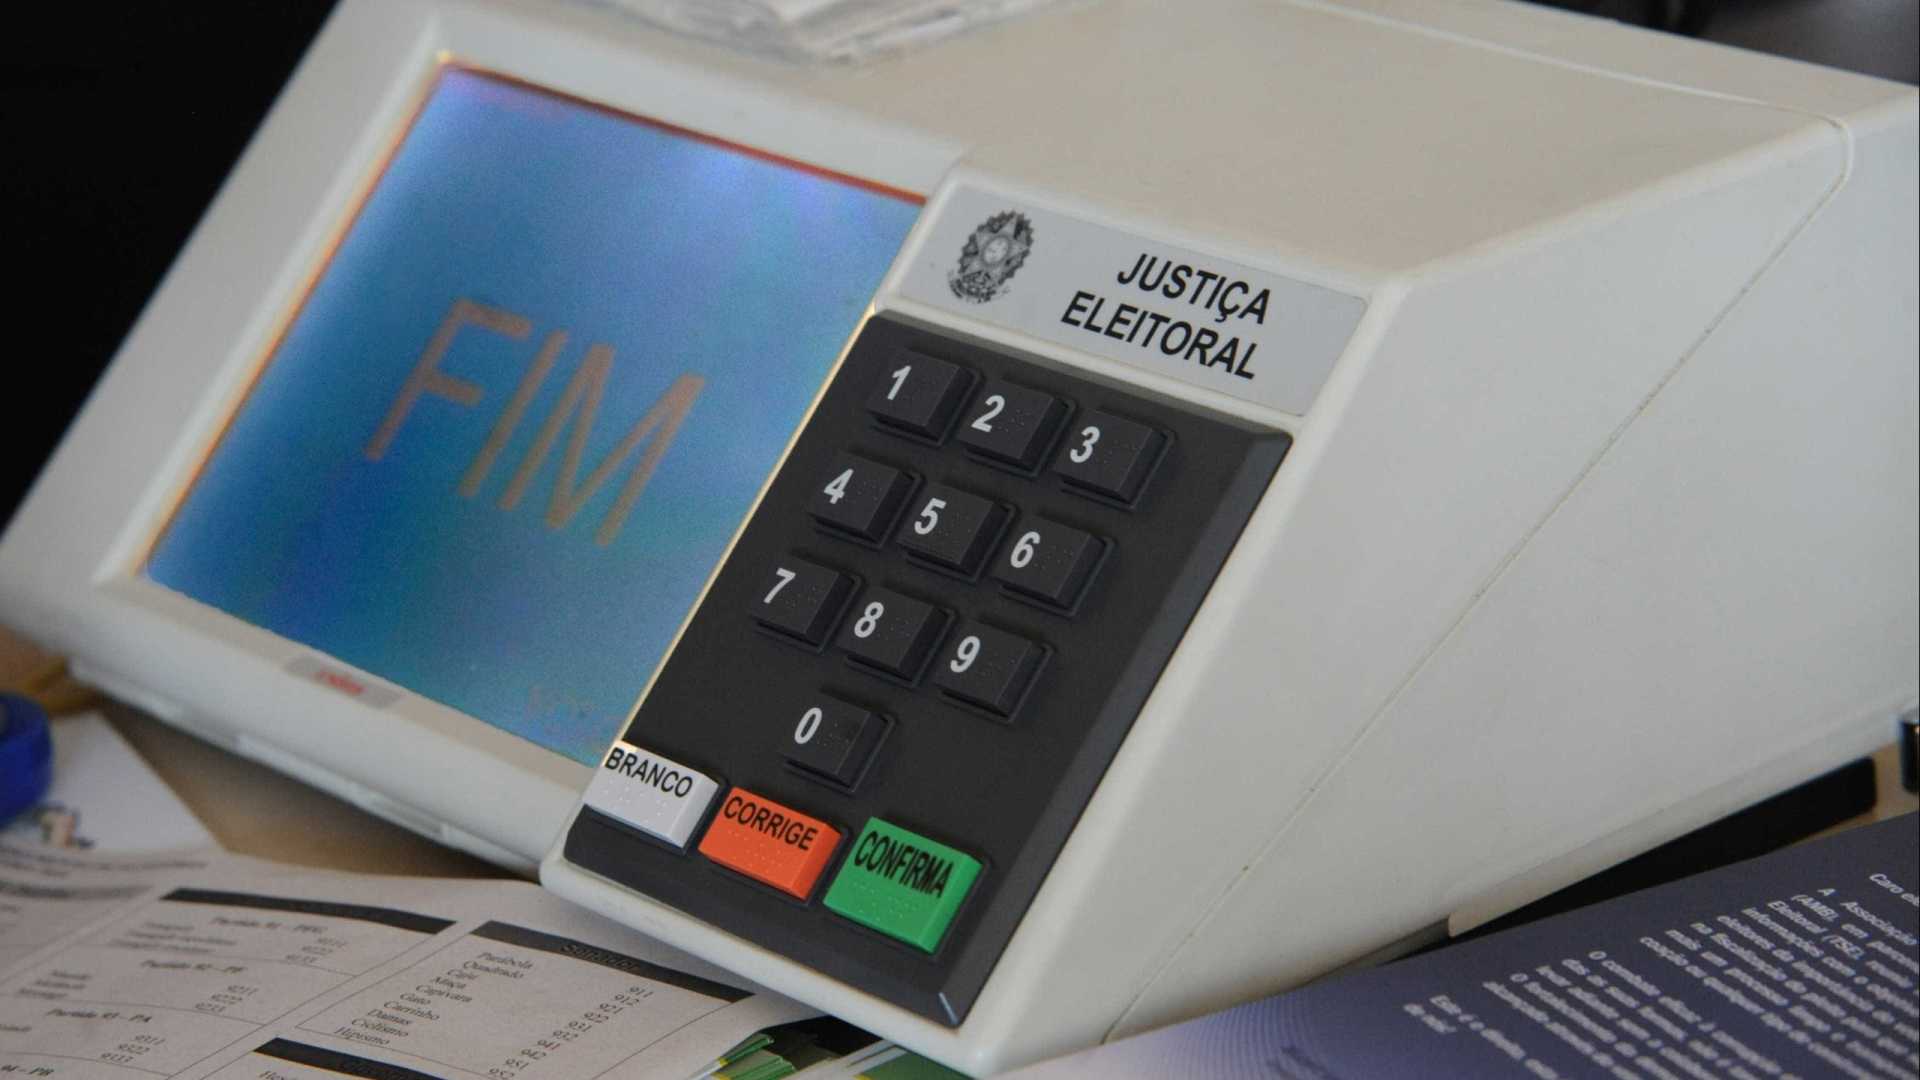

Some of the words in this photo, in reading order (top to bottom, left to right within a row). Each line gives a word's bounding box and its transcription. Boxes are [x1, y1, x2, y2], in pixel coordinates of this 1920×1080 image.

[1117, 253, 1272, 324] JUSTIÇA
[1061, 291, 1258, 380] ELEITORAL
[887, 365, 912, 400] 1
[363, 297, 705, 546] FIM
[971, 395, 1005, 432] 2
[1069, 426, 1100, 463] 3
[824, 469, 854, 504] 4
[914, 498, 946, 535] 5
[1010, 531, 1041, 568] 6
[763, 568, 795, 604] 7
[853, 602, 885, 638] 8
[950, 636, 982, 672] 9
[794, 707, 823, 744] 0
[604, 747, 693, 798] BRANCO
[724, 796, 817, 852] CORRIGE
[854, 831, 954, 899] CONFIRMA
[1869, 873, 1904, 894] Caro
[1767, 900, 1828, 934] Eleitoral
[383, 1000, 440, 1020] Carrinho
